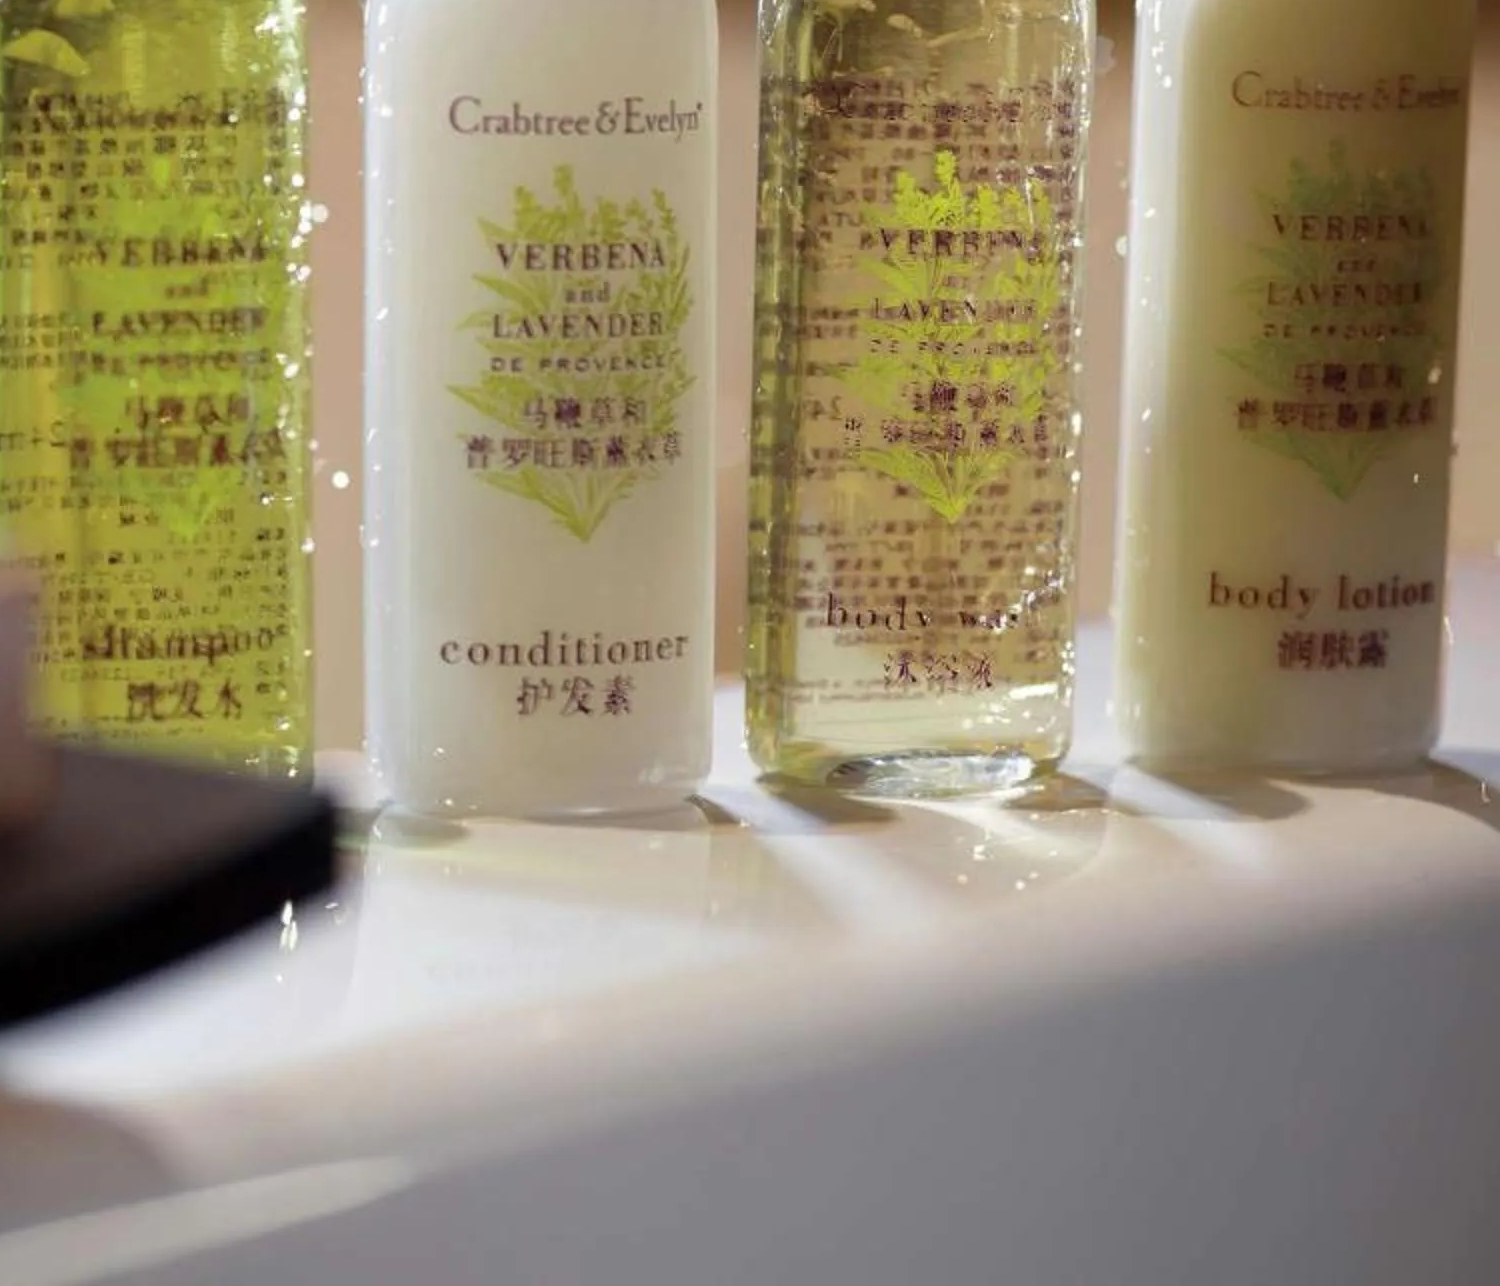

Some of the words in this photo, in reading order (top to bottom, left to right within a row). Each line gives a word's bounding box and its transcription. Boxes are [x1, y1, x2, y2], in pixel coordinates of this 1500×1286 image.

[448, 95, 591, 135] Crabtree
[595, 101, 621, 134] &
[495, 241, 666, 270] VERBENA
[564, 282, 611, 303] and
[493, 312, 663, 339] LAVENDER
[490, 357, 523, 373] DE
[1208, 571, 1319, 619] body
[1338, 575, 1435, 611] lotion
[440, 630, 689, 667] conditioner
[1277, 628, 1390, 670] 润肤露
[516, 675, 637, 716] 护发素
